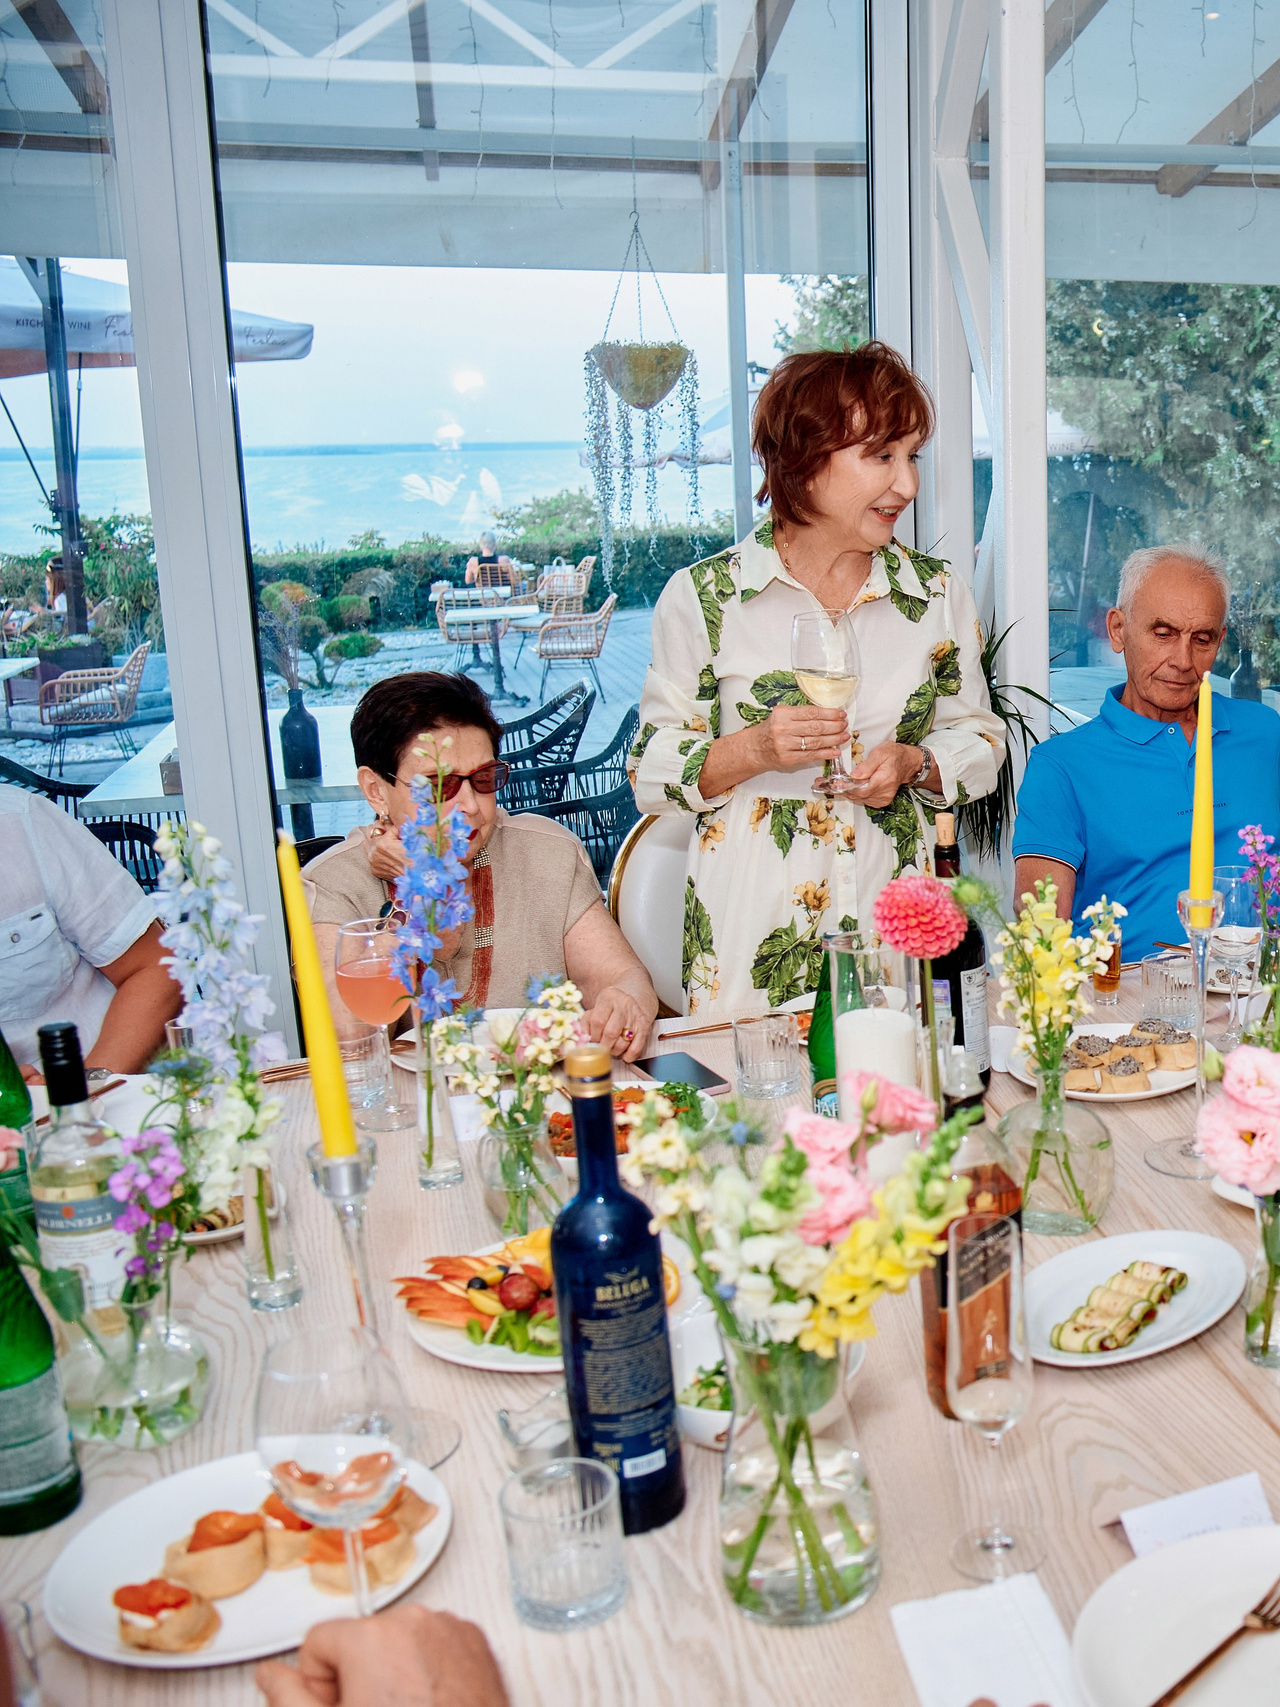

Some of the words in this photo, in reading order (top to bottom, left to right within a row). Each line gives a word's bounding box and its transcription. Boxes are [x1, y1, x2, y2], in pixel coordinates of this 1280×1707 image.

[16, 318, 44, 328] KITCH
[68, 321, 91, 331] WINE
[1049, 442, 1076, 452] WINE
[1176, 808, 1194, 817] TOMM
